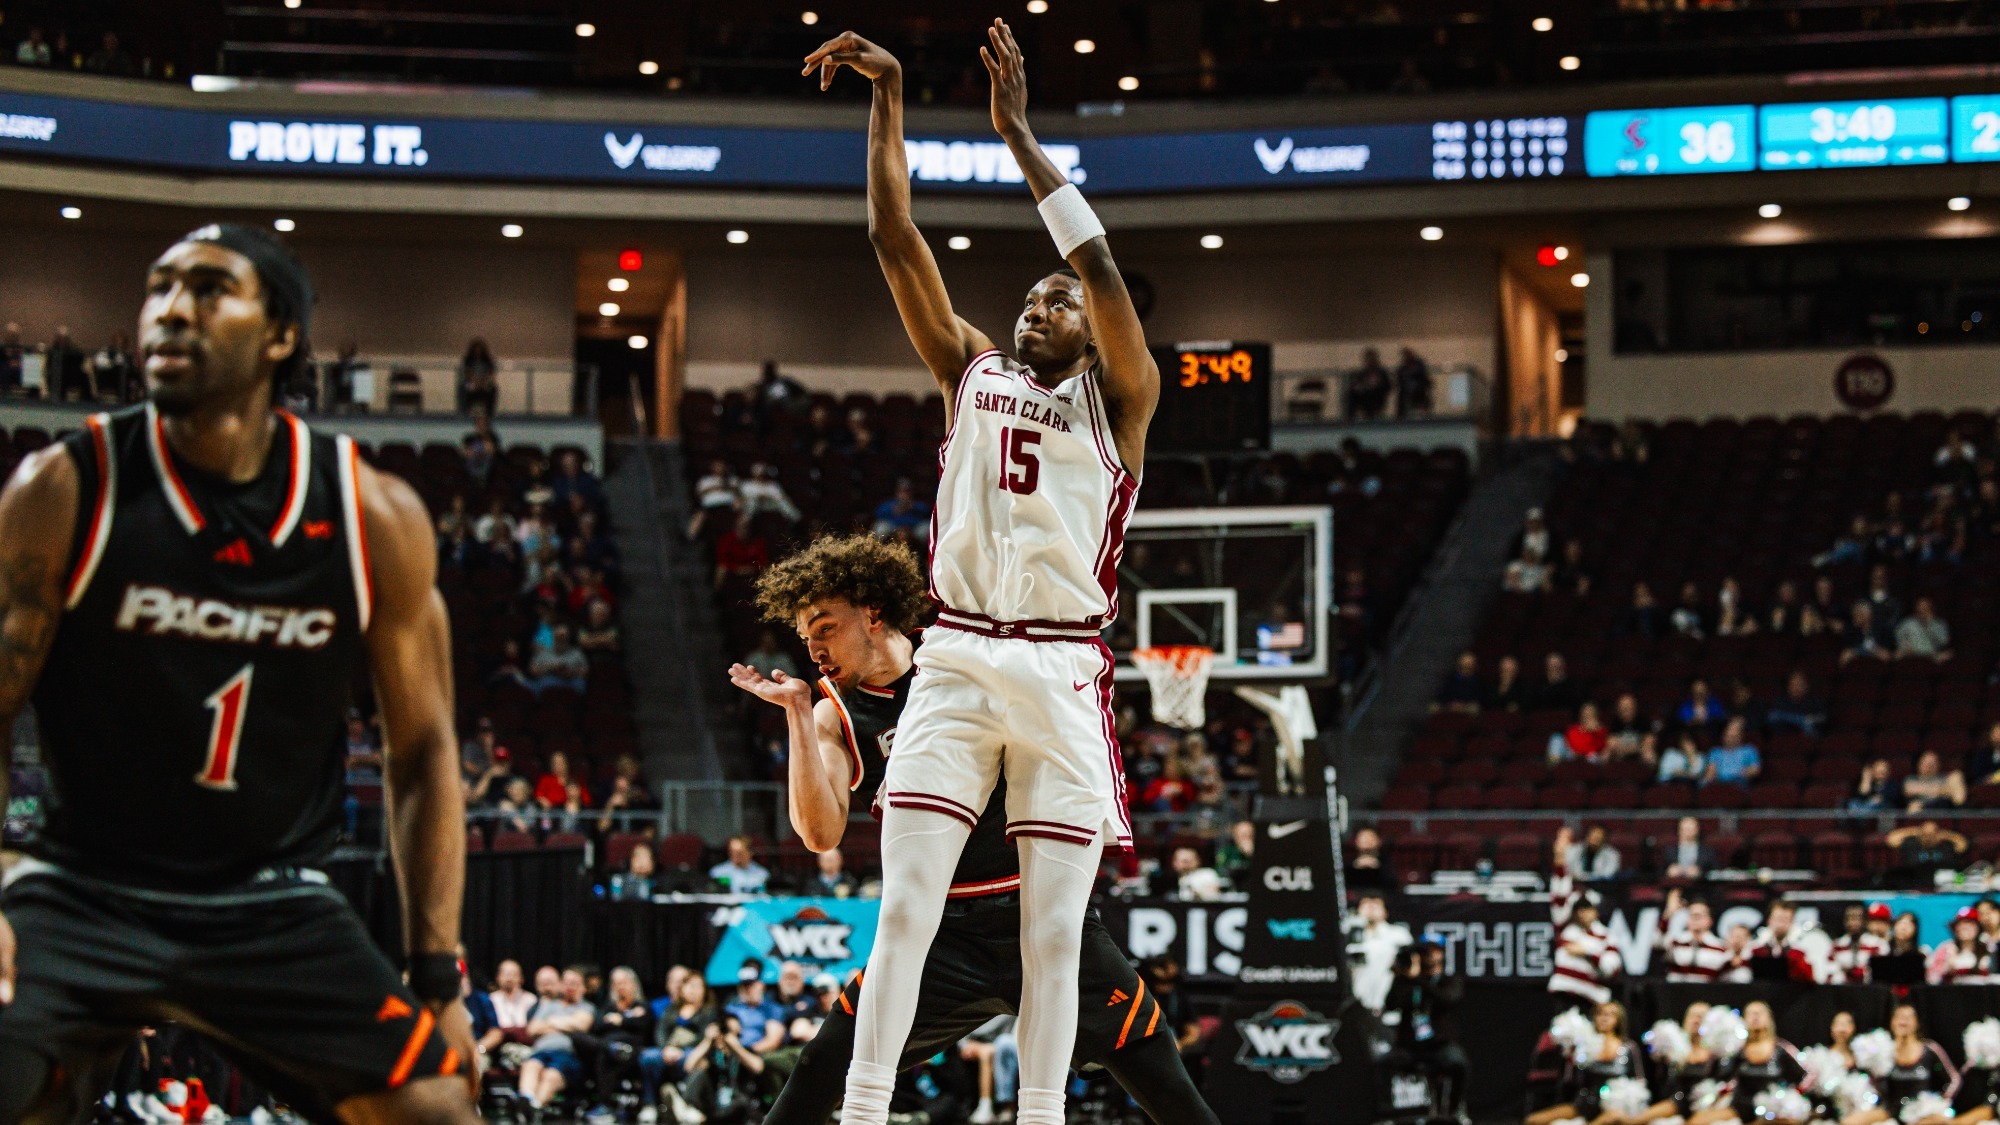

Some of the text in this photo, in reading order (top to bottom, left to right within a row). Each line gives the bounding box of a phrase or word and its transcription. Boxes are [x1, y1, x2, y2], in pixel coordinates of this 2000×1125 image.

[229, 121, 428, 166] PROVE IT.
[1680, 122, 1734, 164] 36
[1810, 105, 1896, 143] 3:49
[1180, 350, 1252, 387] 3:49
[975, 391, 1071, 433] SANTA CLARA
[999, 426, 1042, 495] 15
[116, 585, 336, 648] PACIFIC
[194, 662, 255, 791] 1
[770, 924, 851, 958] WCC
[1424, 921, 1553, 977] THE
[1244, 1024, 1333, 1059] WCC
